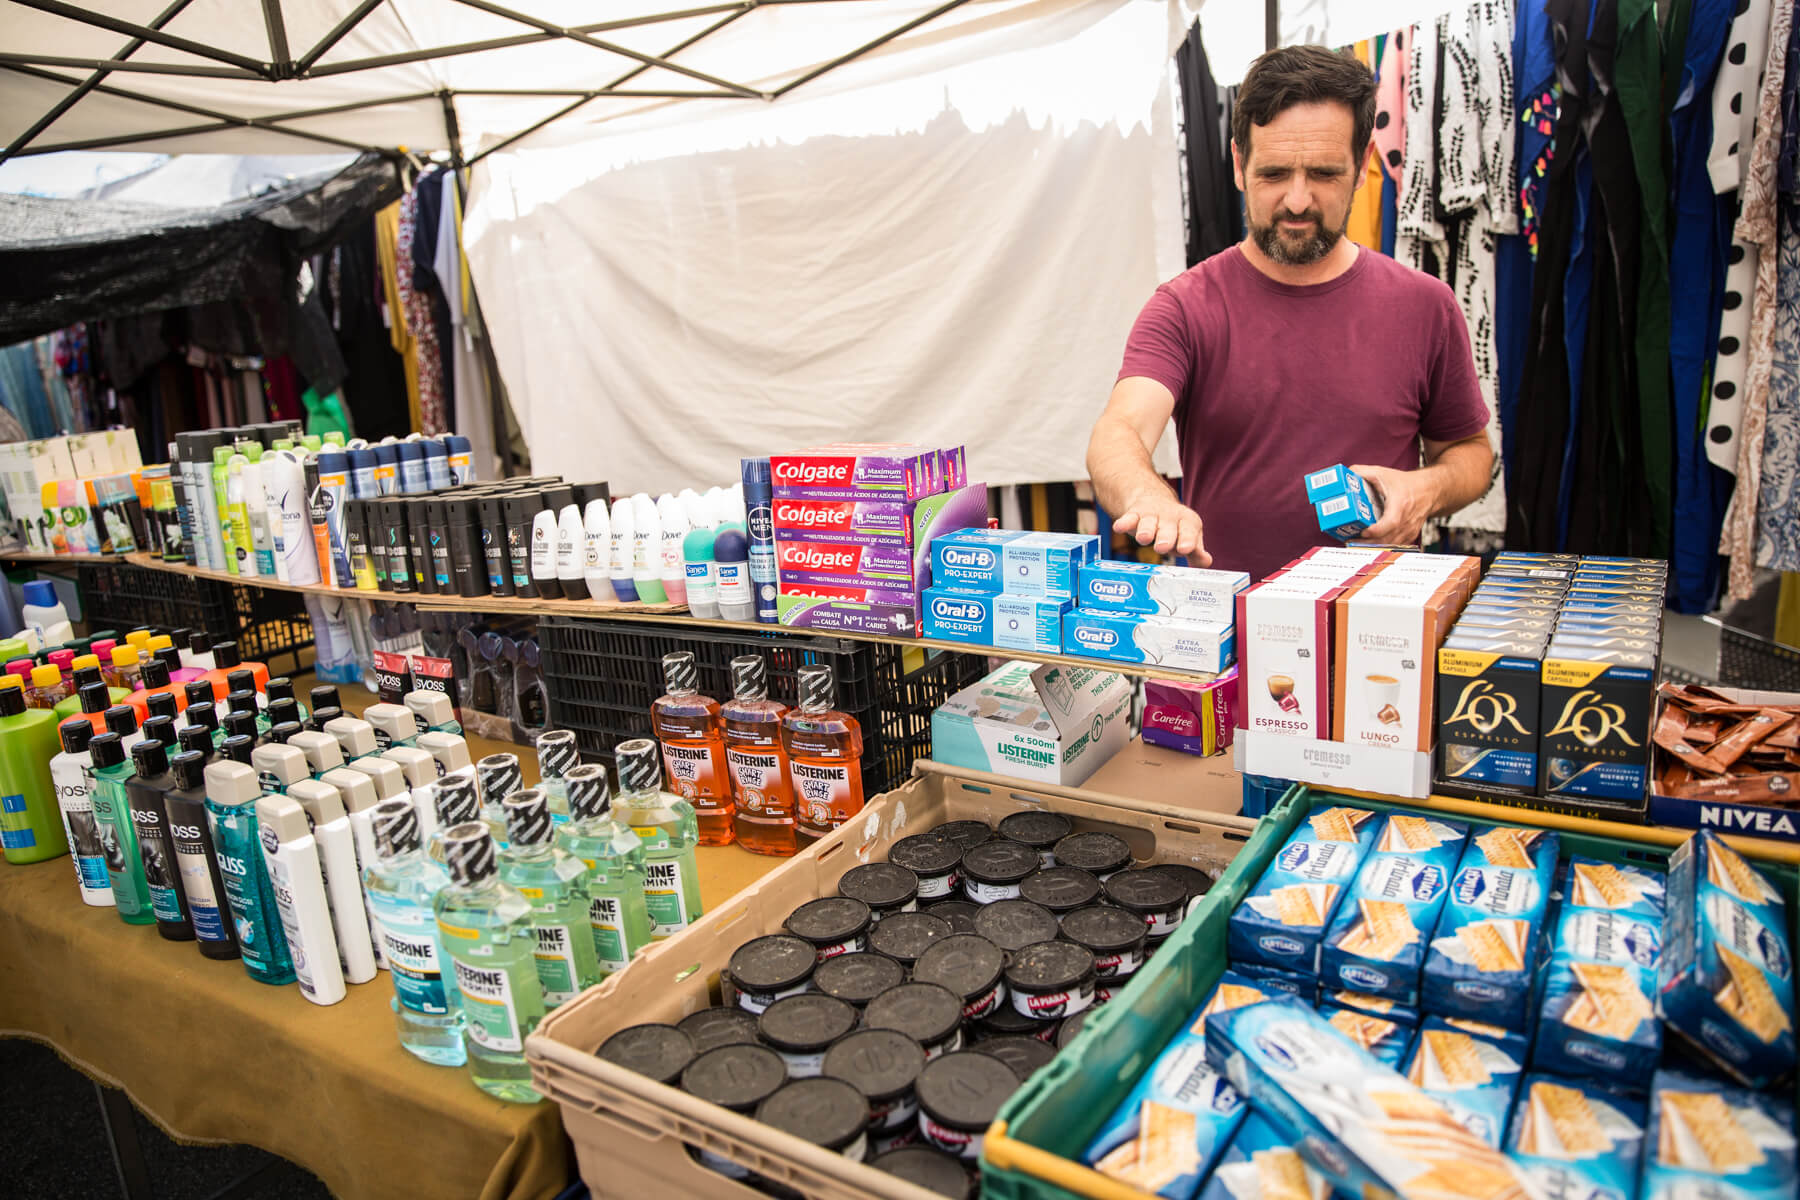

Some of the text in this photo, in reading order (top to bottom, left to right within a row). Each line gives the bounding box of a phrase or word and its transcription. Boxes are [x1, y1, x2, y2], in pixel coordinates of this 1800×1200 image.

[776, 462, 848, 482] Colgate
[777, 505, 847, 526] Colgate
[866, 513, 900, 521] Maximum
[661, 531, 682, 540] Dove
[783, 547, 854, 569] Colgate
[873, 557, 907, 565] Maximum
[946, 551, 990, 562] Oral-B
[944, 568, 993, 580] PRO-EXPERT
[1093, 582, 1129, 595] Oral-B
[1191, 589, 1213, 597] EXTRA
[1189, 596, 1217, 604] BRANCO
[813, 610, 841, 618] COMBATE
[936, 602, 980, 618] Oral-B
[820, 618, 840, 626] CAUSA
[866, 622, 887, 630] CARIES
[934, 620, 984, 633] PRO-EXPERT
[1078, 630, 1114, 643] Oral-B
[1175, 645, 1203, 653] BRANCO
[1443, 659, 1483, 668] ALUMINIUM
[376, 673, 401, 687] syoss
[1547, 669, 1590, 678] ALUMINIUM
[416, 679, 445, 691] syoss
[1091, 684, 1101, 697] THIS
[1101, 676, 1113, 689] SIDE
[1442, 679, 1533, 736] L'OR
[1152, 711, 1192, 728] Carefree
[1216, 687, 1226, 748] Carefree
[1255, 717, 1309, 731] ESPRESSO
[1544, 690, 1641, 747] L'OR
[1014, 734, 1055, 749] 6x 500ml
[1360, 731, 1400, 744] LUNGO
[1454, 730, 1520, 744] ESPRESSO
[663, 744, 709, 760] LISTERINE
[1063, 730, 1091, 763] LISTERINE
[1556, 743, 1627, 757] ESPRESSO
[729, 750, 776, 767] LISTERINE
[997, 742, 1056, 765] LISTERINE
[1303, 748, 1352, 766] cremesso
[672, 760, 696, 771] SMART
[1005, 755, 1048, 769] FRESH BURST
[674, 768, 695, 779] RINSE
[738, 767, 763, 777] SMART
[792, 762, 845, 780] LISTERINE
[740, 775, 762, 787] RINSE
[803, 780, 830, 791] SMART
[804, 789, 829, 801] RINSE
[1700, 805, 1797, 835] NIVEA
[1029, 993, 1069, 1009] LA PIARA
